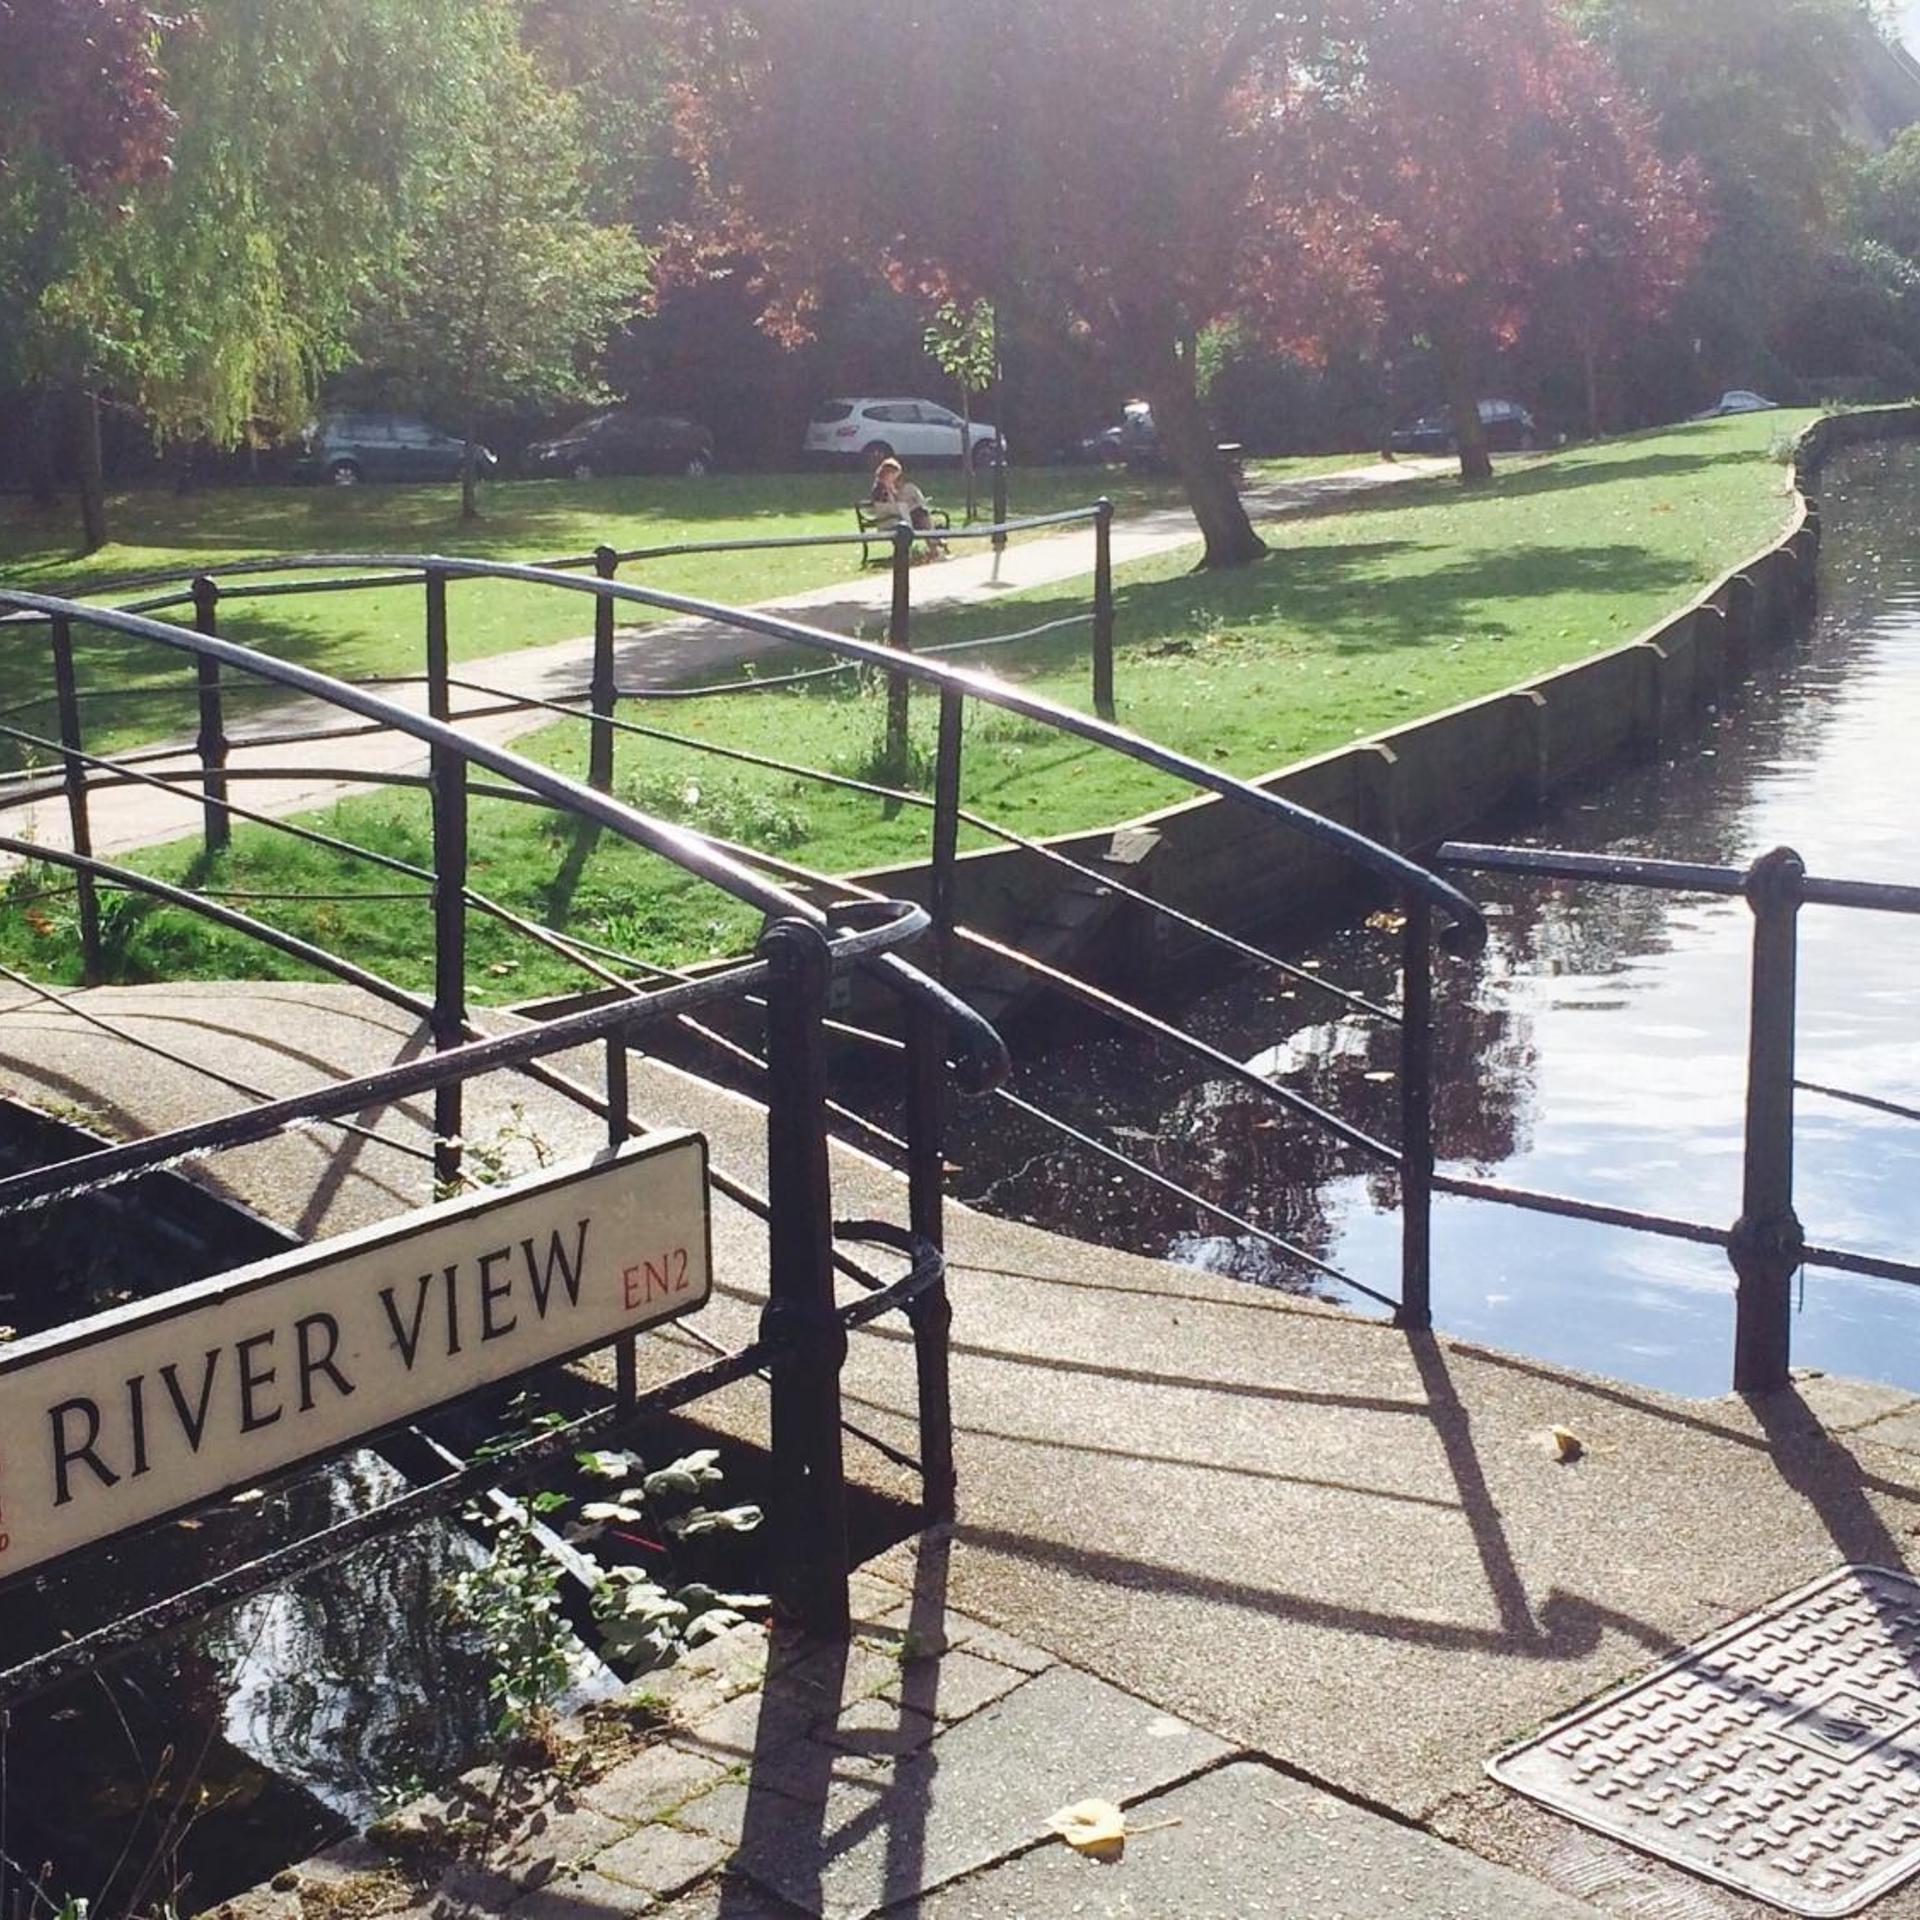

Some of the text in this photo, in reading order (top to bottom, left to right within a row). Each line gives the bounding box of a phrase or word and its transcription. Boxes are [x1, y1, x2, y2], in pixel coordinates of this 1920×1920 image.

[48, 1311, 356, 1507] RIVER
[379, 1218, 591, 1371] VIEW
[622, 1248, 689, 1310] EN2
